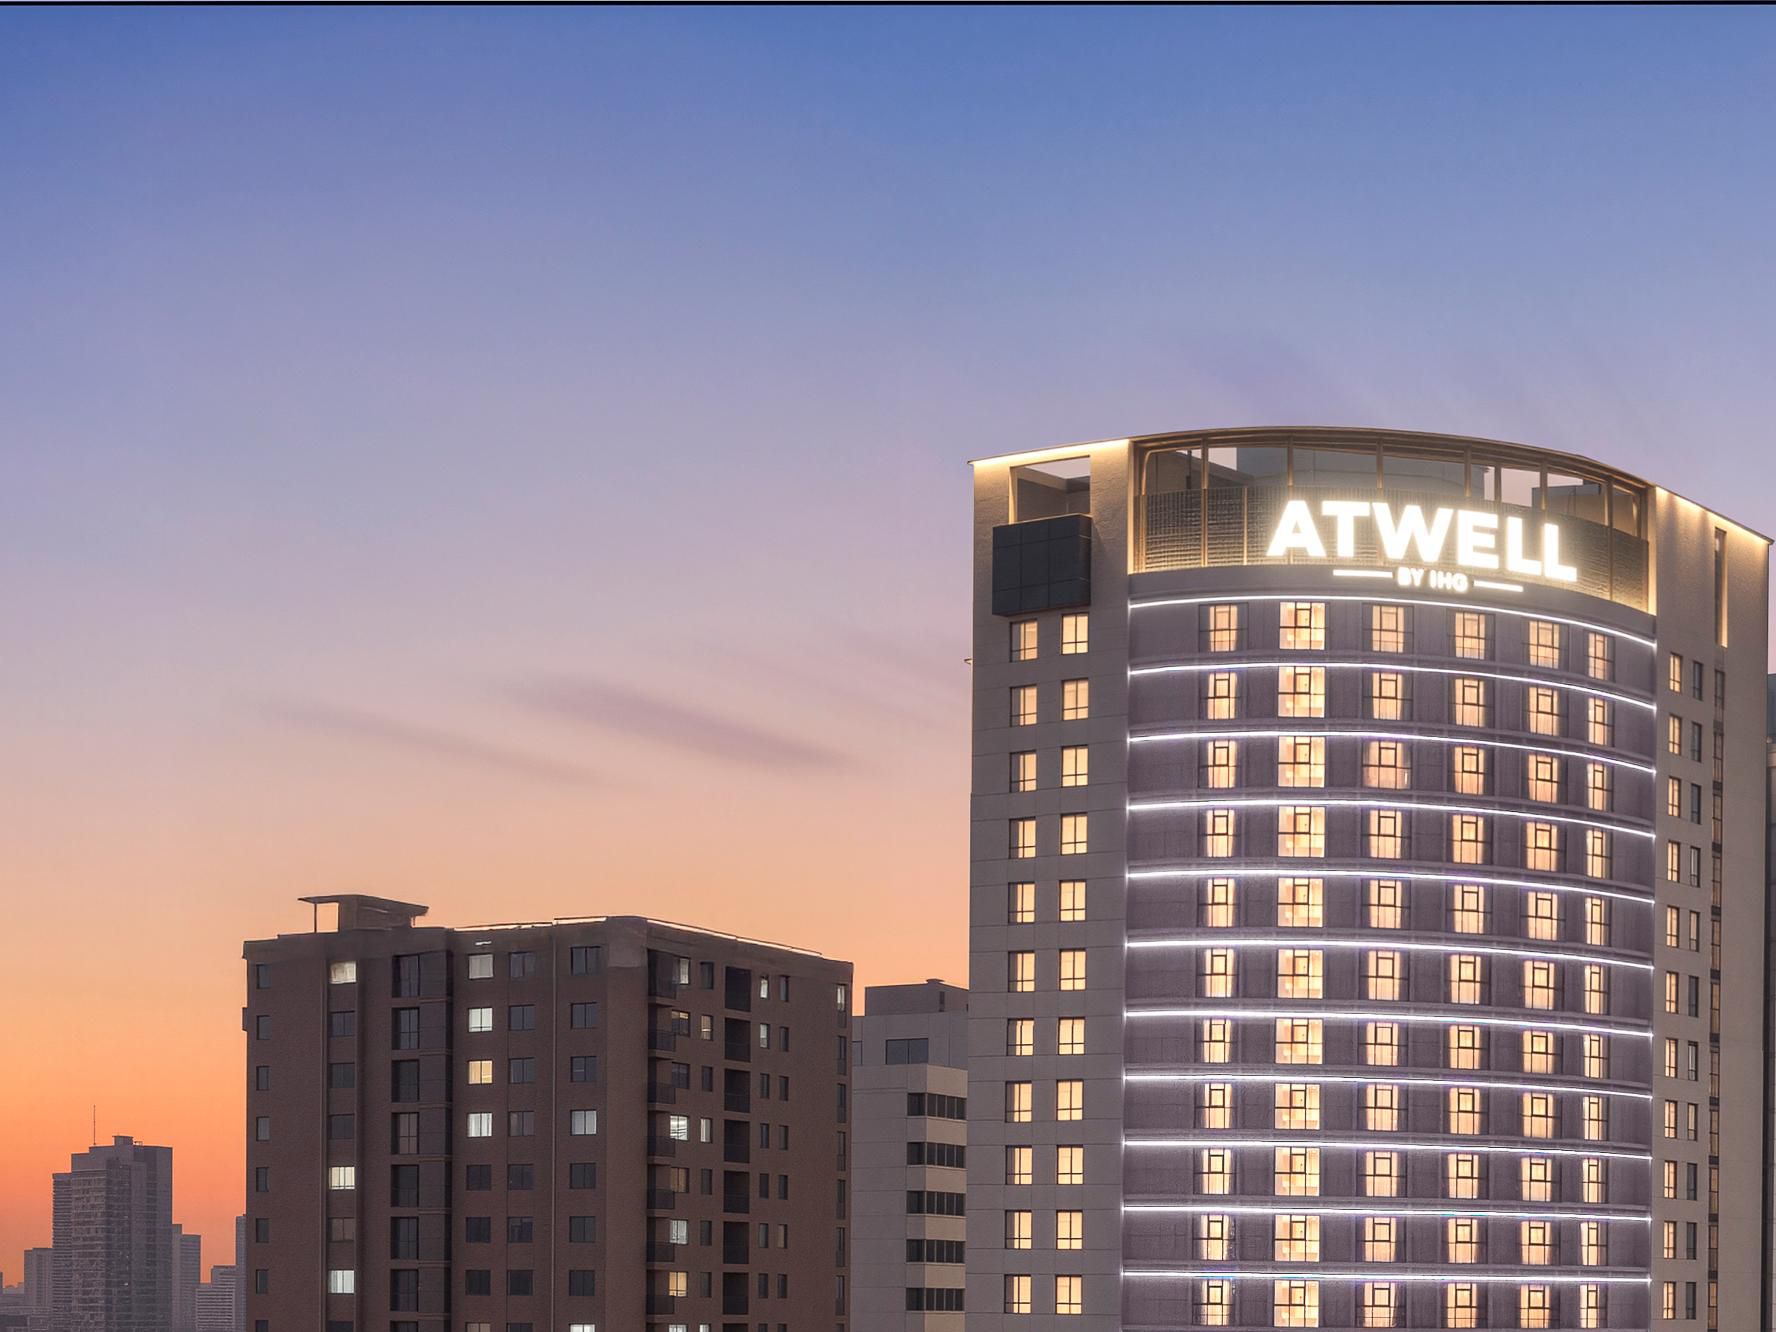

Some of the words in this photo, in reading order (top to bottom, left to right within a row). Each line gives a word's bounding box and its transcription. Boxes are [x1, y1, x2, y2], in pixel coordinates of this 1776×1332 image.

[1266, 500, 1577, 582] ATWELL
[1398, 567, 1424, 586] BY
[1430, 570, 1468, 592] IHG
